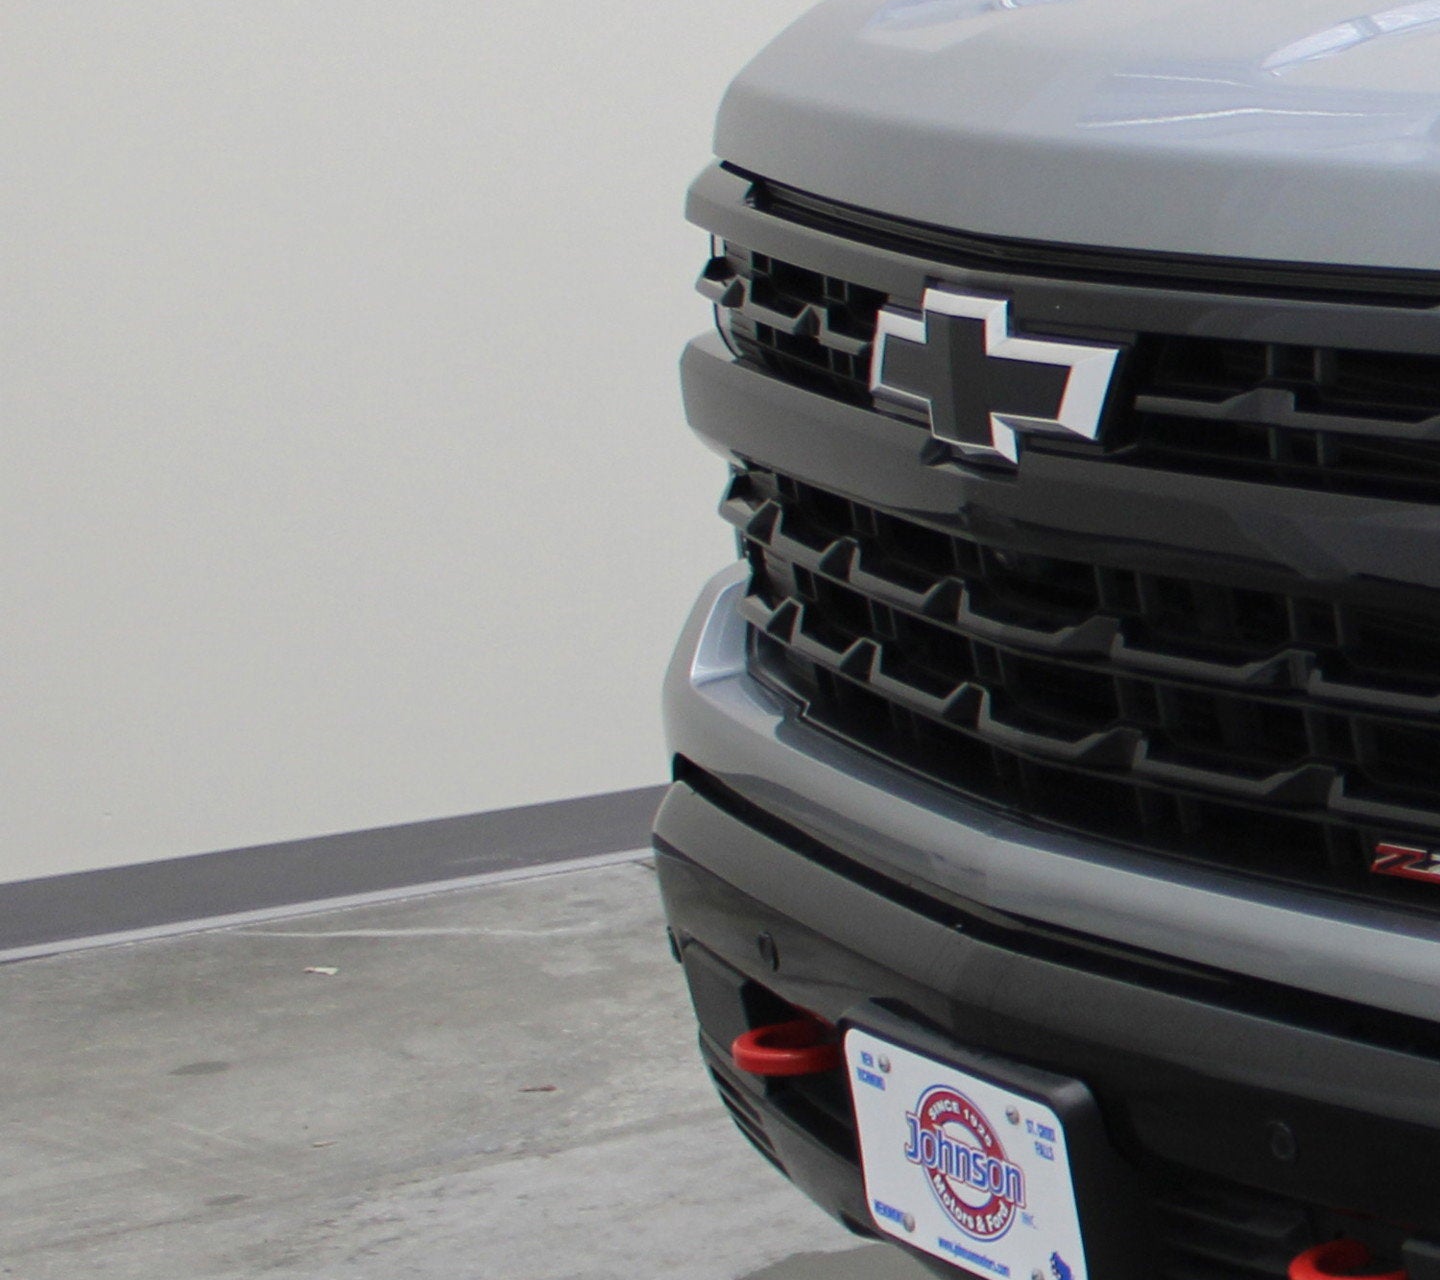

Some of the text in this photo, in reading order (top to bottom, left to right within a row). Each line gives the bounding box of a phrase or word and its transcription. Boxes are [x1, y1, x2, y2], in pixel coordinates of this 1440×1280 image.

[928, 1099, 961, 1121] SINCE
[906, 1112, 1027, 1209] Johnson
[933, 1173, 975, 1230] Motors
[985, 1199, 1010, 1232] Ford
